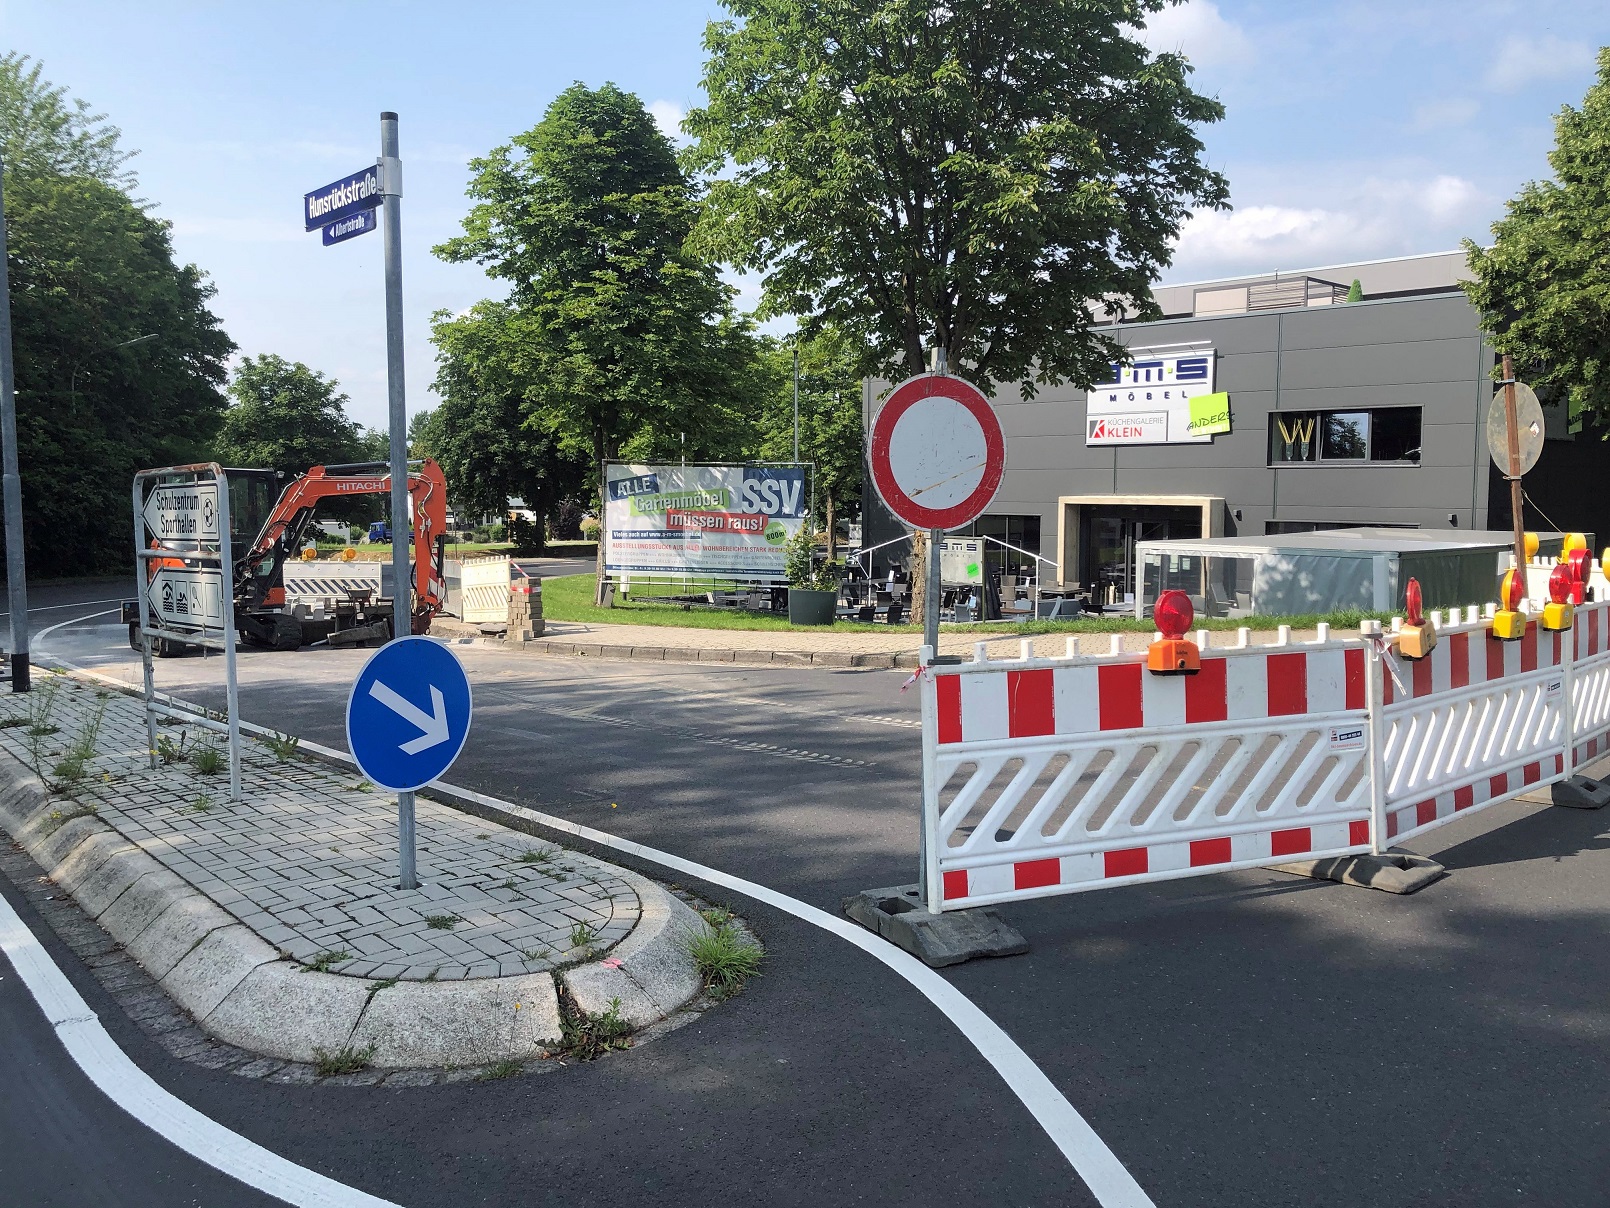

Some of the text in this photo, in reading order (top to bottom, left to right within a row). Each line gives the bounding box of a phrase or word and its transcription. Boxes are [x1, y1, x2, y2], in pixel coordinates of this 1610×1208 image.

[309, 172, 377, 219] Hunsrückstraße
[1109, 390, 1188, 403] MÖBEL
[1107, 416, 1165, 426] KÜCHENGALERIE
[1107, 427, 1143, 438] KLEIN
[336, 481, 386, 491] HITACHI
[617, 476, 653, 497] ALLE
[156, 491, 200, 512] Schulzentrum
[635, 490, 725, 512] Gartenmöbel
[742, 478, 802, 515] SSV
[160, 514, 197, 537] Sporthallen
[669, 511, 724, 530] müssen
[727, 514, 763, 531] raus!
[703, 545, 749, 553] WOHNBEREICHEN
